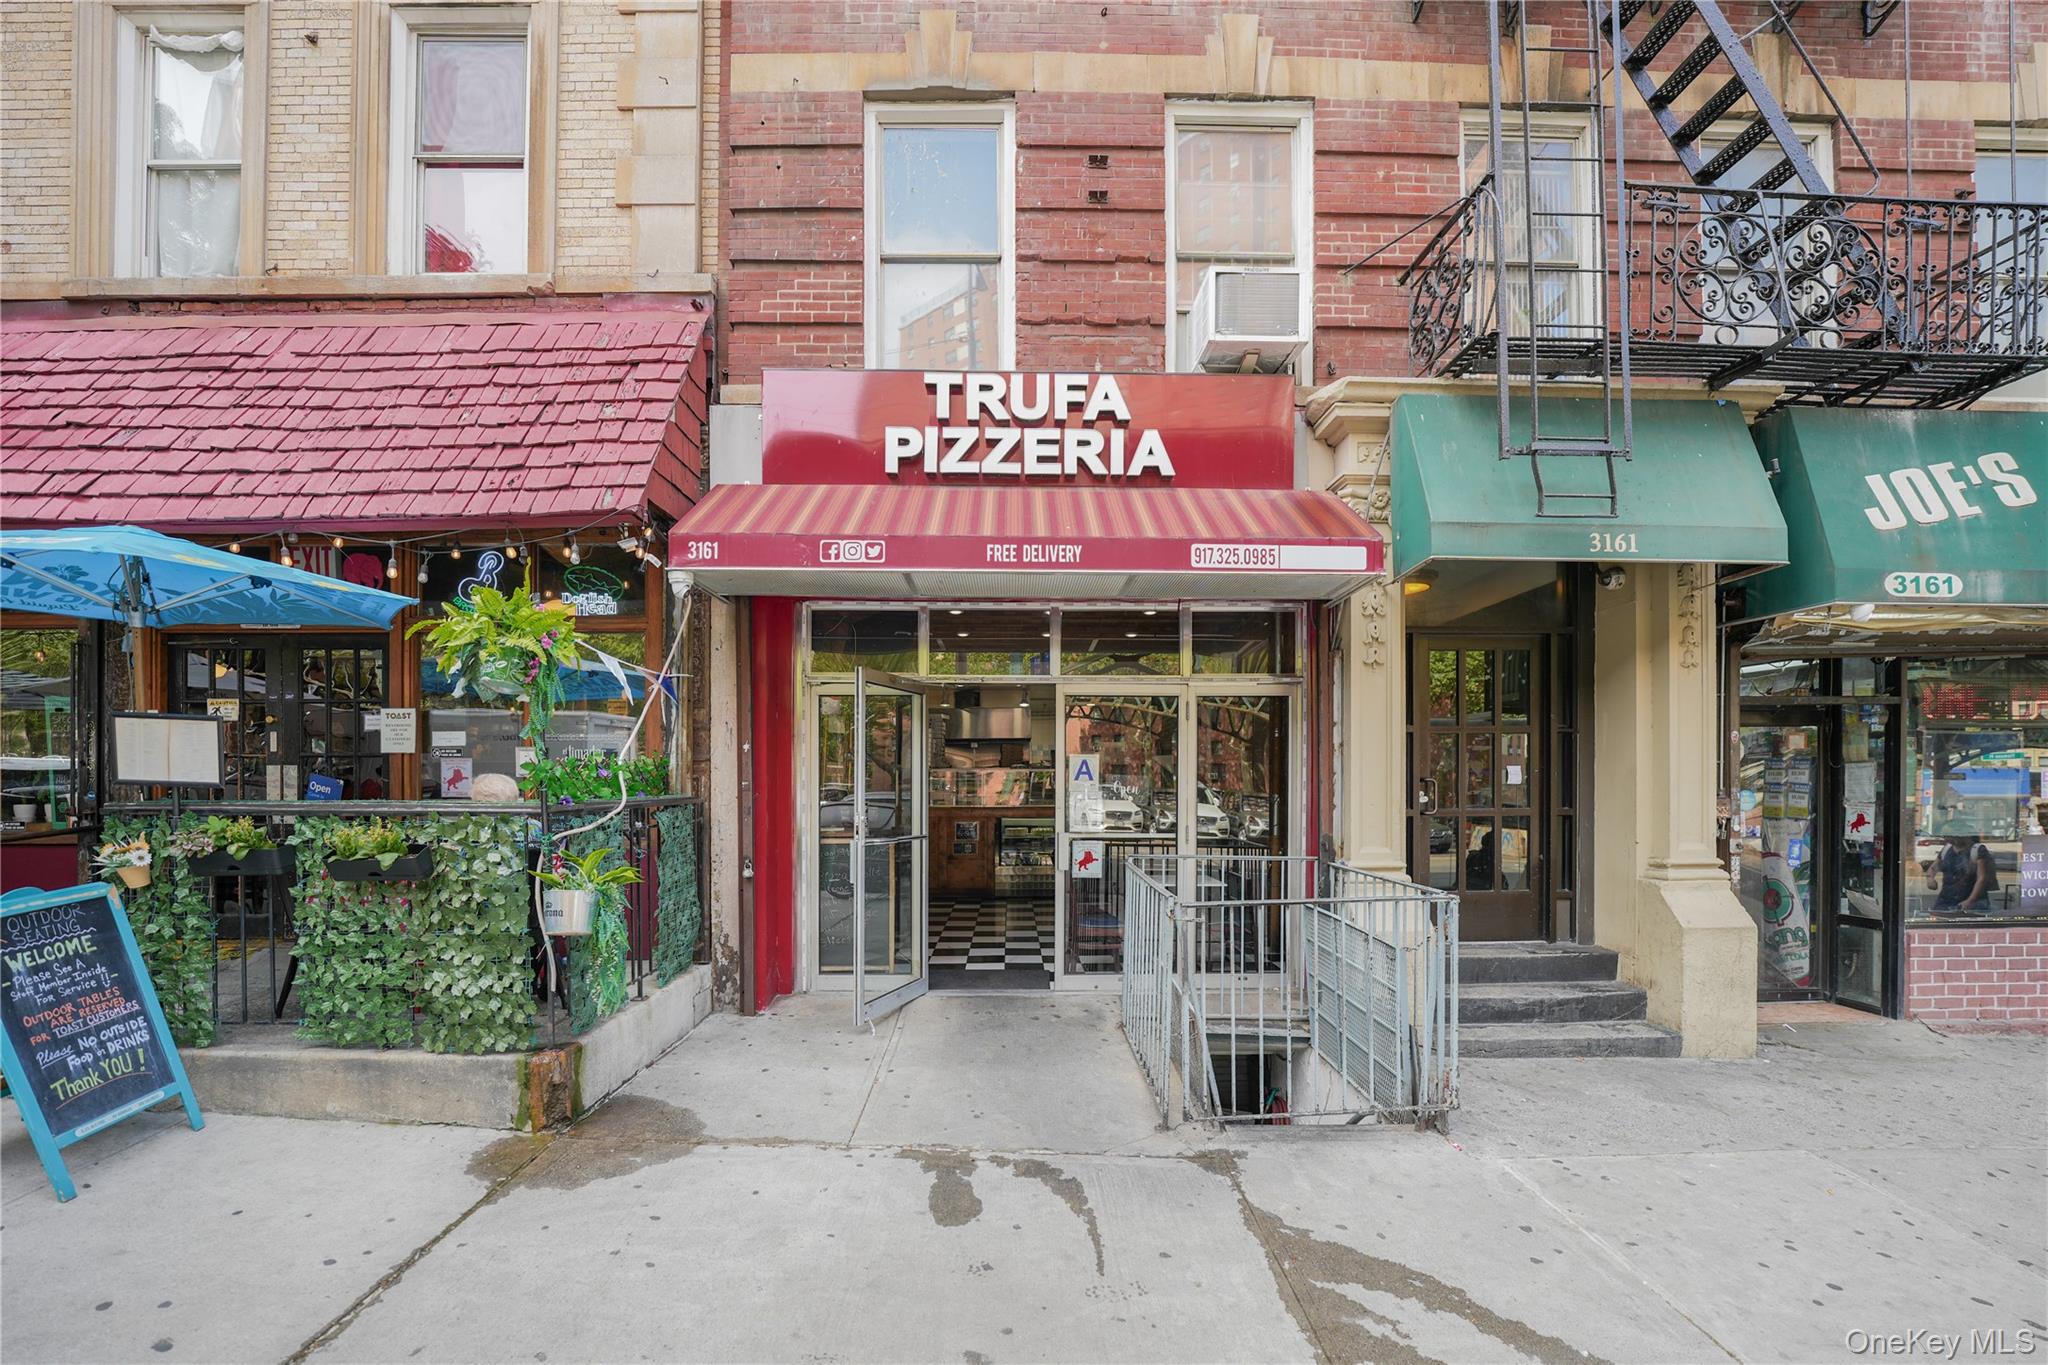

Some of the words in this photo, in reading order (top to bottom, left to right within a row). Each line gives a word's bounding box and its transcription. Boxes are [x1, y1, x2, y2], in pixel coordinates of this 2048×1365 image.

[923, 371, 1132, 422] TRUFA
[884, 425, 1176, 477] PIZZERIA
[1863, 451, 2038, 531] JOE'S
[687, 541, 719, 559] 3161
[985, 543, 1018, 562] FREE
[1022, 544, 1083, 563] DELIVERY
[1193, 547, 1276, 566] 917.325.0985
[1589, 532, 1639, 553] 3161
[289, 546, 332, 577] EXIT
[561, 591, 613, 605] Dogfish
[1892, 574, 1954, 594] 3161
[575, 601, 617, 616] Head
[384, 712, 412, 720] TOAST
[1074, 758, 1094, 781] A
[309, 781, 331, 795] Open
[7, 903, 86, 933] OUTDOOR
[12, 919, 80, 946] SEATING
[4, 935, 98, 973] WELCOME
[10, 986, 35, 1002] Staff
[38, 976, 72, 992] Member
[72, 963, 107, 981] Inside
[13, 971, 52, 989] Please
[53, 962, 73, 976] See
[75, 958, 86, 970] A
[58, 979, 97, 997] Service
[23, 1002, 77, 1028] OUTDOOR
[77, 986, 121, 1007] TABLES
[51, 1013, 74, 1029] ARE
[79, 997, 126, 1017] RESERVED
[52, 1019, 84, 1037] TOAST
[86, 1000, 141, 1025] CUSTOMERS
[35, 1045, 75, 1067] Please
[78, 1036, 97, 1050] NO
[100, 1016, 148, 1040] OUTSIDE
[107, 1030, 150, 1055] DRINKS
[50, 1067, 105, 1101] Thank
[99, 1052, 133, 1079] YOU
